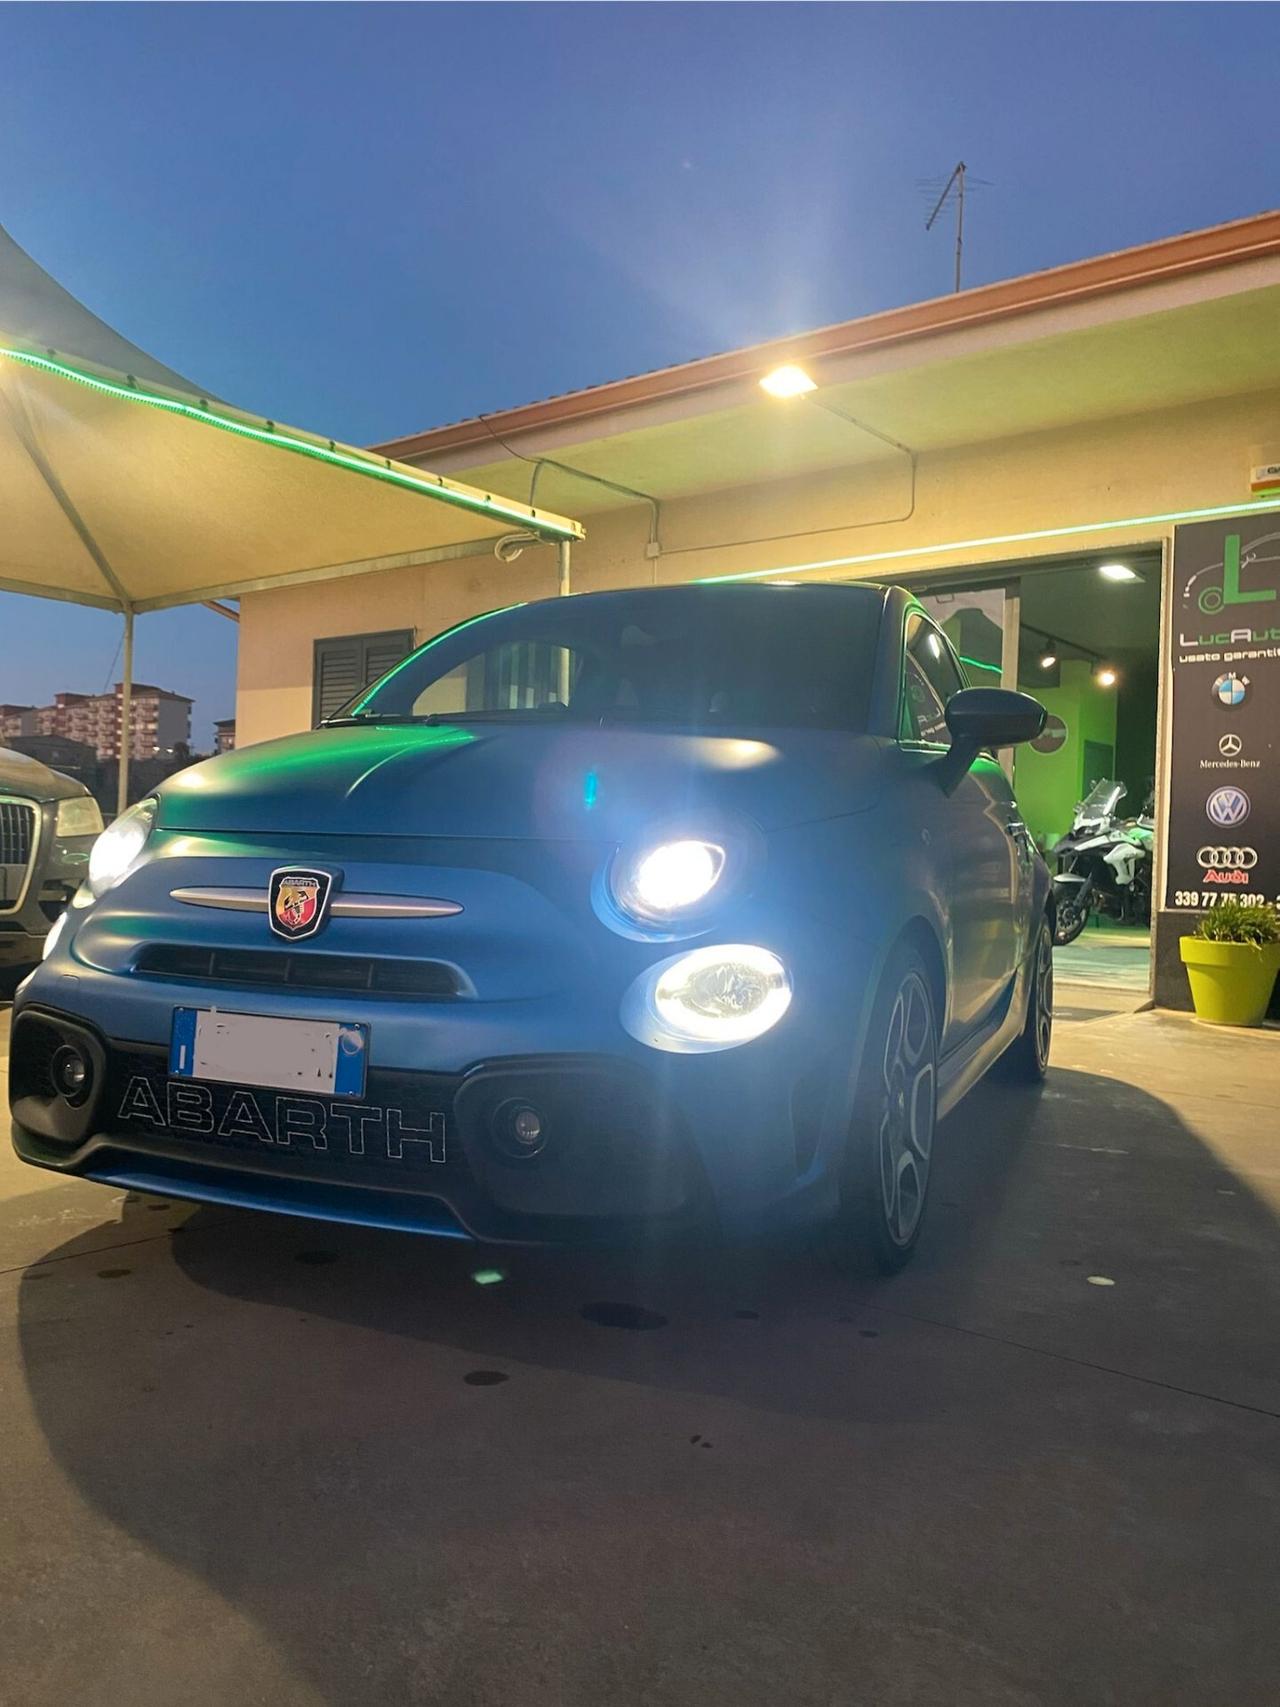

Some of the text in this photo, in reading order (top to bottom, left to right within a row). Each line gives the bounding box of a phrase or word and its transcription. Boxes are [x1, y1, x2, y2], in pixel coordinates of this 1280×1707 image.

[1179, 653, 1220, 663] usato
[1200, 760, 1261, 769] Mercedes-Benz
[1202, 869, 1249, 884] Audi
[284, 879, 317, 887] ABARTH
[1175, 891, 1199, 906] 339
[1201, 892, 1218, 907] 77
[1240, 893, 1265, 909] 302
[118, 1076, 446, 1163] ABARTH
